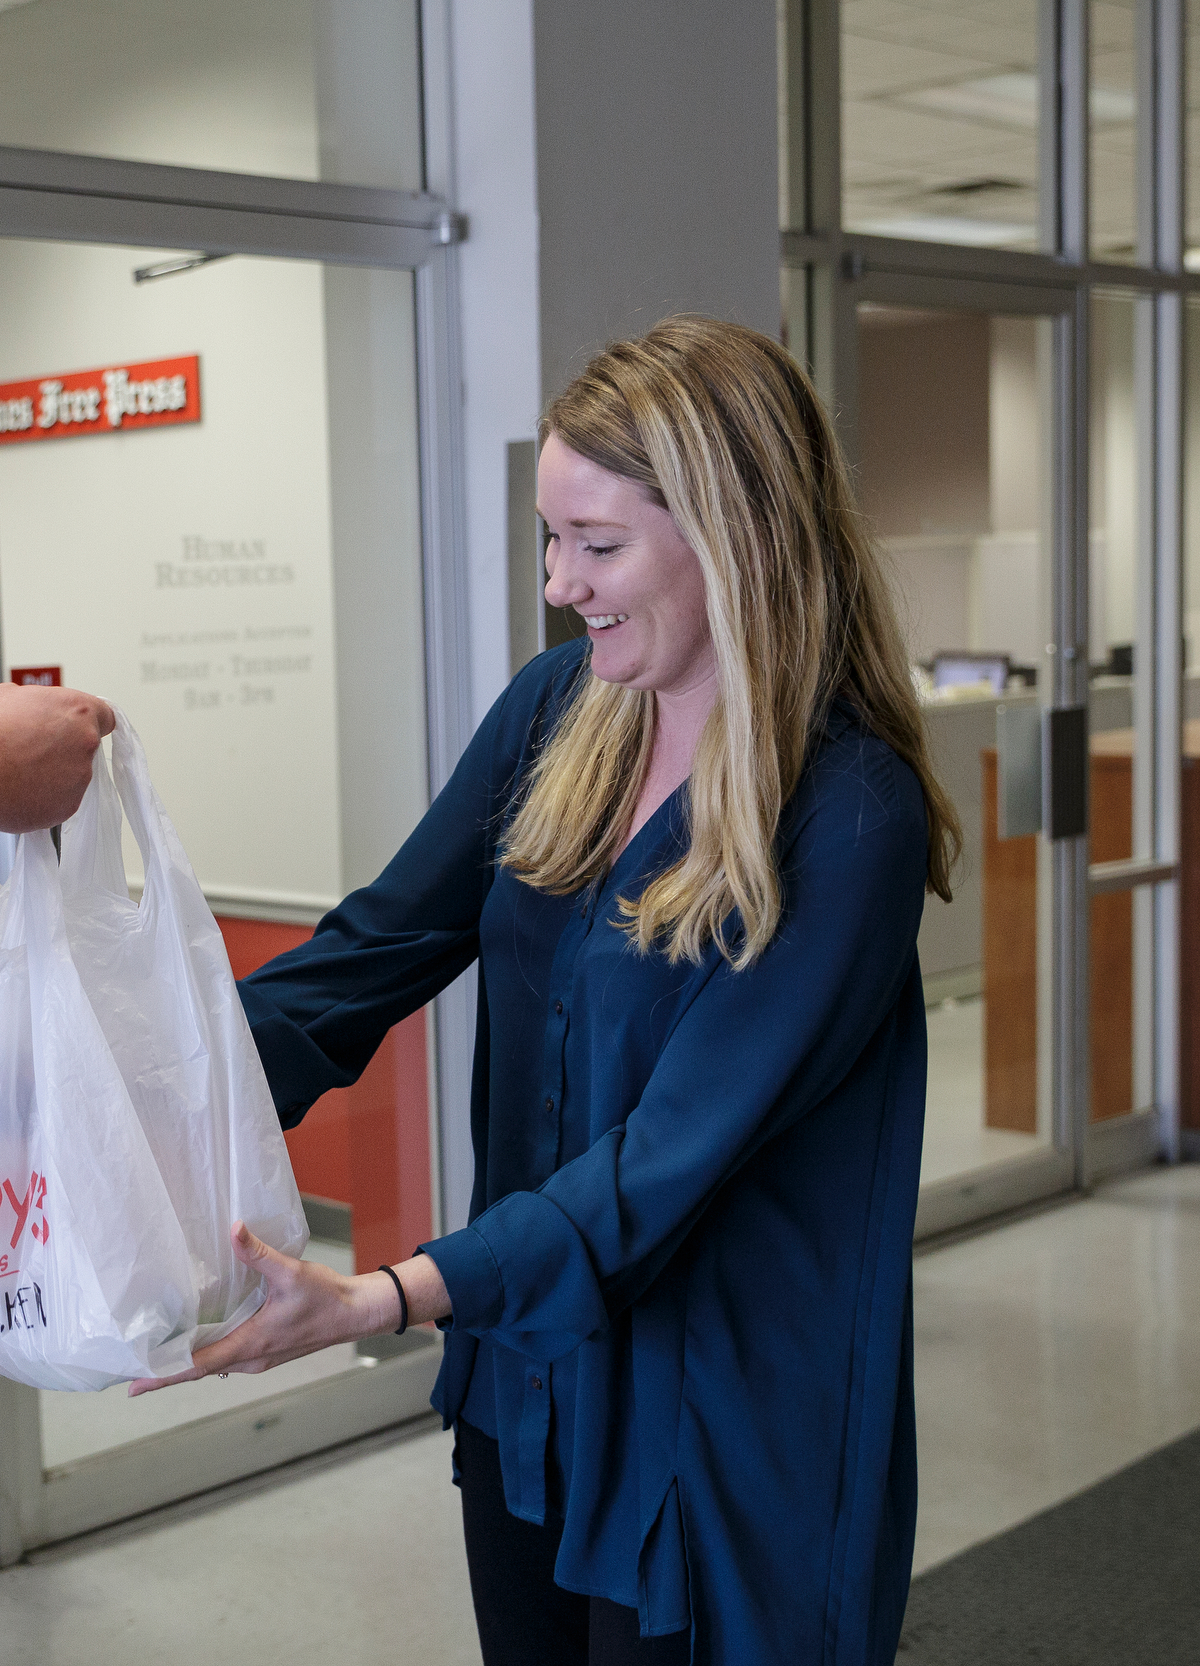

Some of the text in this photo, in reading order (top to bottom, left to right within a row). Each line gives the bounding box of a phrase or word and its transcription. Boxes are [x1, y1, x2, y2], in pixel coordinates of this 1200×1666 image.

[38, 381, 100, 428] Free
[103, 369, 186, 427] Press
[182, 536, 266, 561] HUMAN
[155, 562, 295, 588] RESOURCES
[140, 660, 209, 683] MONDAY
[231, 654, 312, 676] THURSDAY
